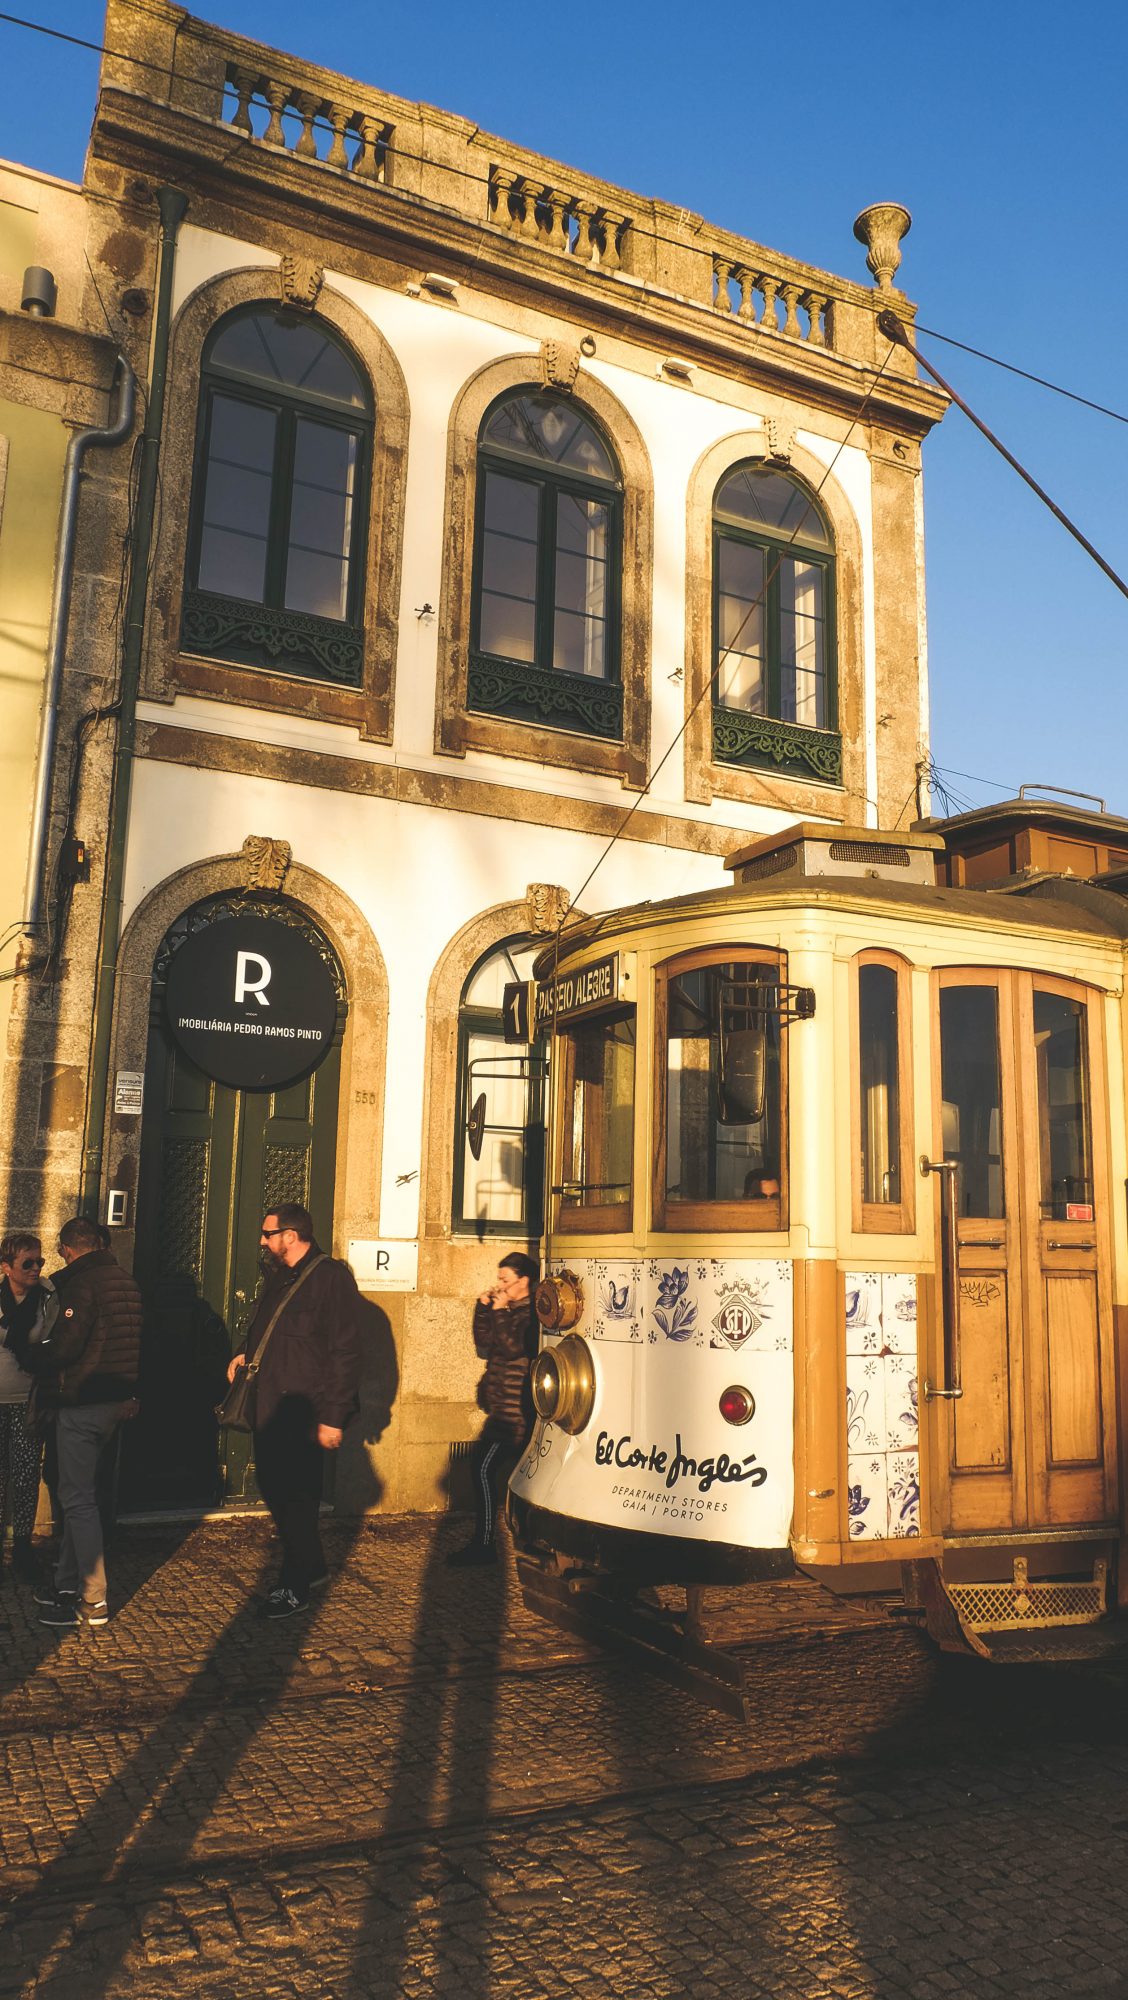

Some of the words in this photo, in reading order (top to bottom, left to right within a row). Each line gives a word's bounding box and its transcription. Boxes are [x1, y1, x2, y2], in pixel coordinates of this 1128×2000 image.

[234, 951, 271, 1005] R
[575, 966, 610, 1006] ALEGRE
[178, 1018, 232, 1032] IMOBILIÁRIA
[233, 1023, 263, 1035] PEDRO
[264, 1026, 295, 1038] RAMOS
[297, 1029, 322, 1040] PINTO
[510, 993, 520, 1034] 1
[376, 1250, 390, 1271] R
[595, 1431, 615, 1466] El
[614, 1435, 668, 1474] Corte
[665, 1433, 768, 1493] Inglés
[611, 1485, 677, 1505] DEPARTMENT
[681, 1498, 728, 1513] STORES
[622, 1500, 647, 1512] GAIA
[662, 1507, 704, 1522] PORTO
